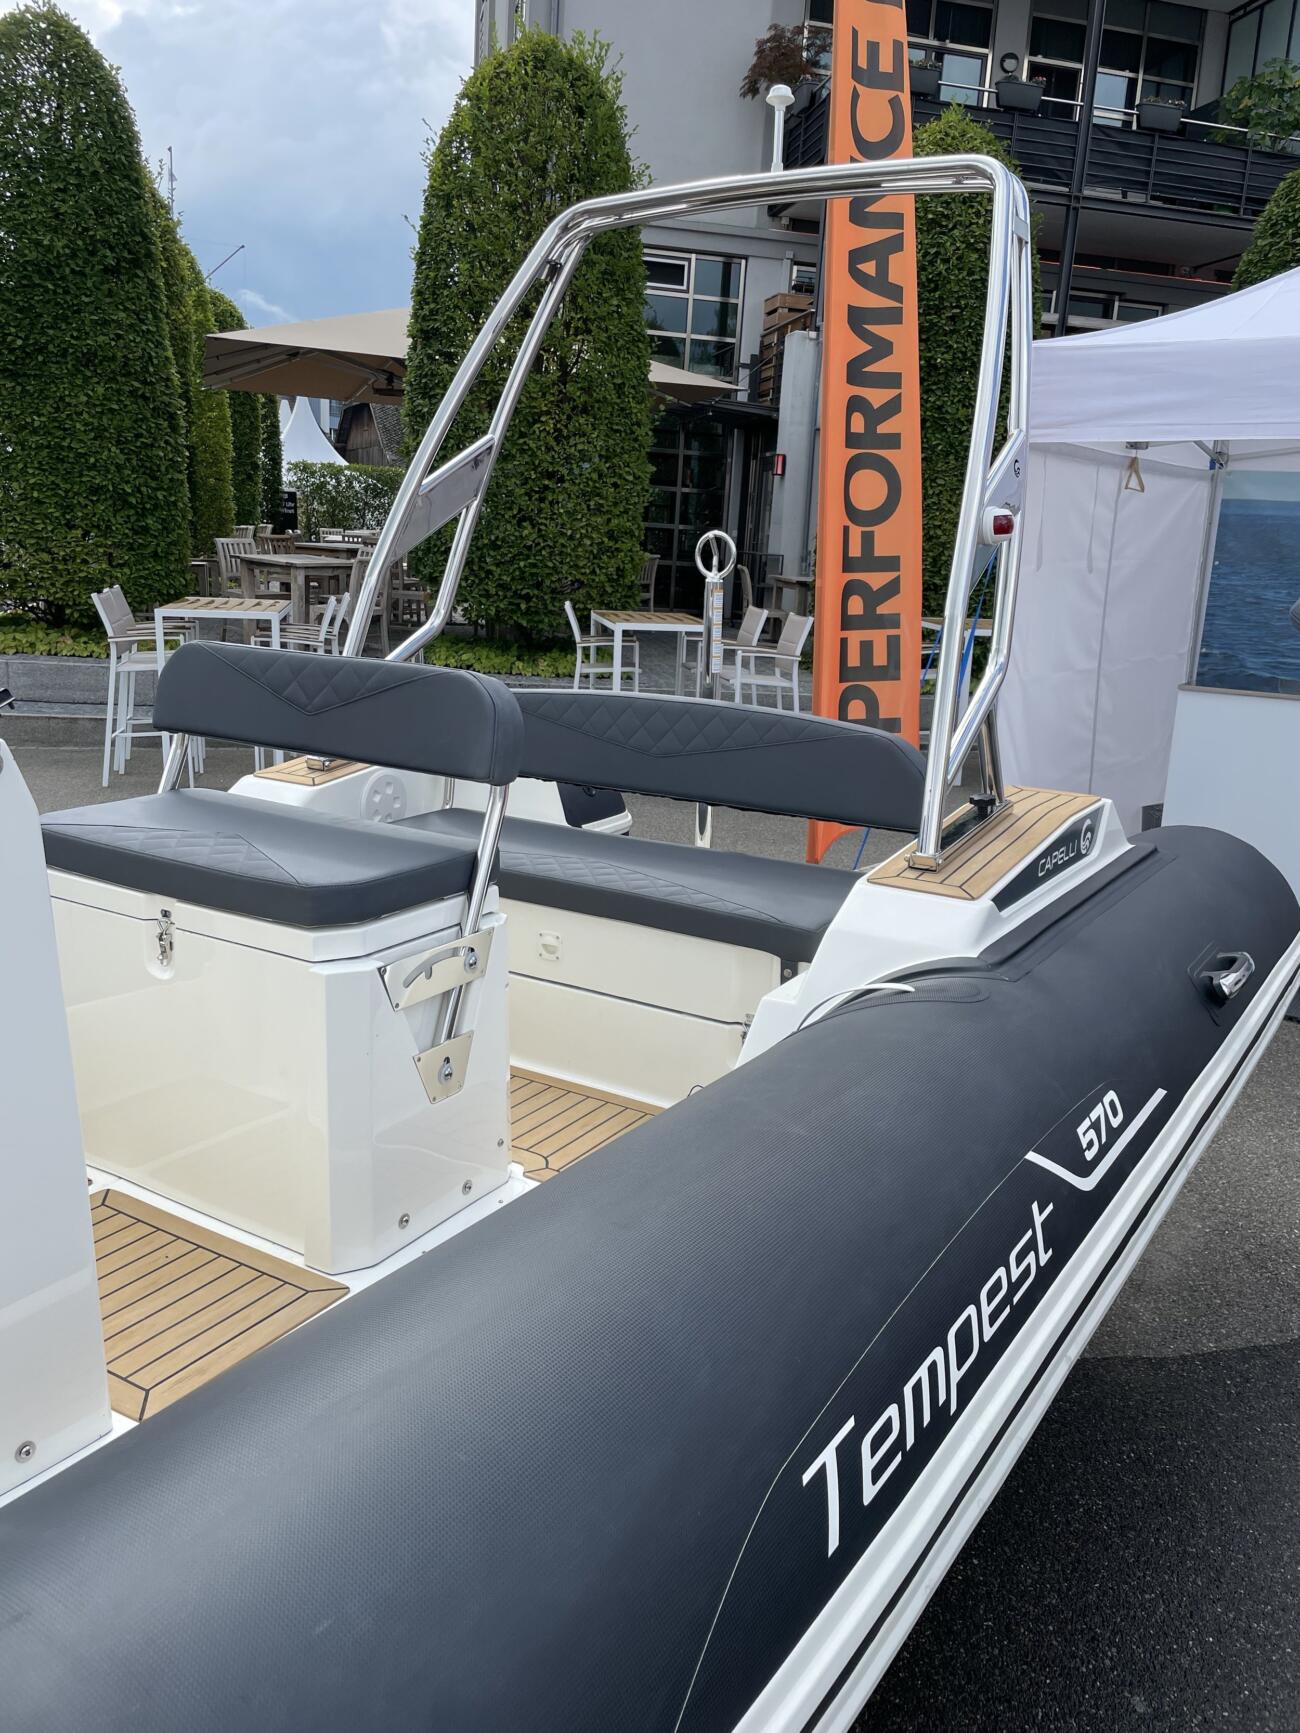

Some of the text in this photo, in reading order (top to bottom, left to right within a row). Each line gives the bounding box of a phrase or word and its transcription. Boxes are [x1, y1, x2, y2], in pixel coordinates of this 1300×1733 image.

[1038, 839, 1078, 877] CAPELLI
[802, 1090, 1124, 1558] Tempest 570
